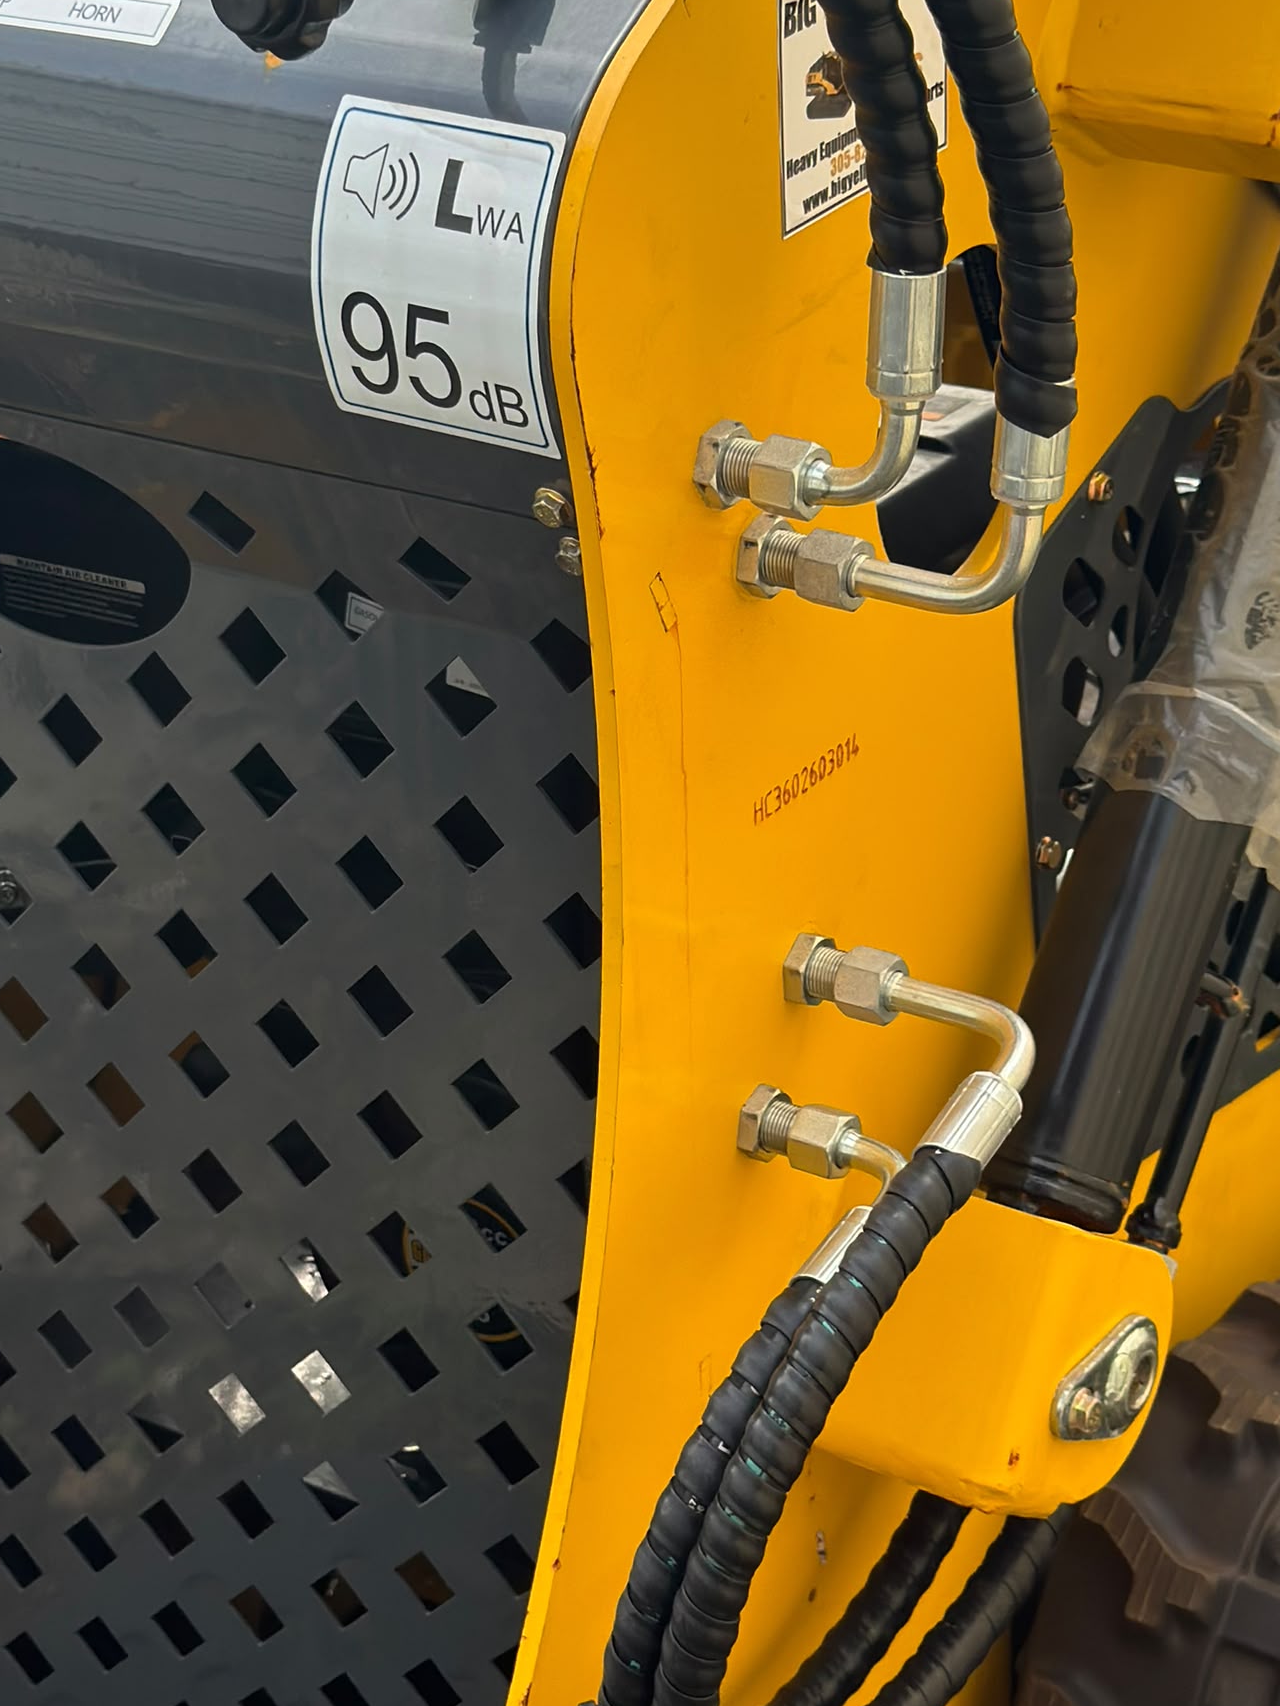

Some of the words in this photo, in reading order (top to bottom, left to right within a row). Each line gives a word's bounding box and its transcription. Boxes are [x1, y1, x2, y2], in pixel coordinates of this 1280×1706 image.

[67, 1, 123, 24] HORN
[786, 148, 818, 181] Heavy
[819, 126, 858, 162] Equipm
[802, 163, 867, 215] www.bigyell
[752, 732, 861, 827] HC3602603014
